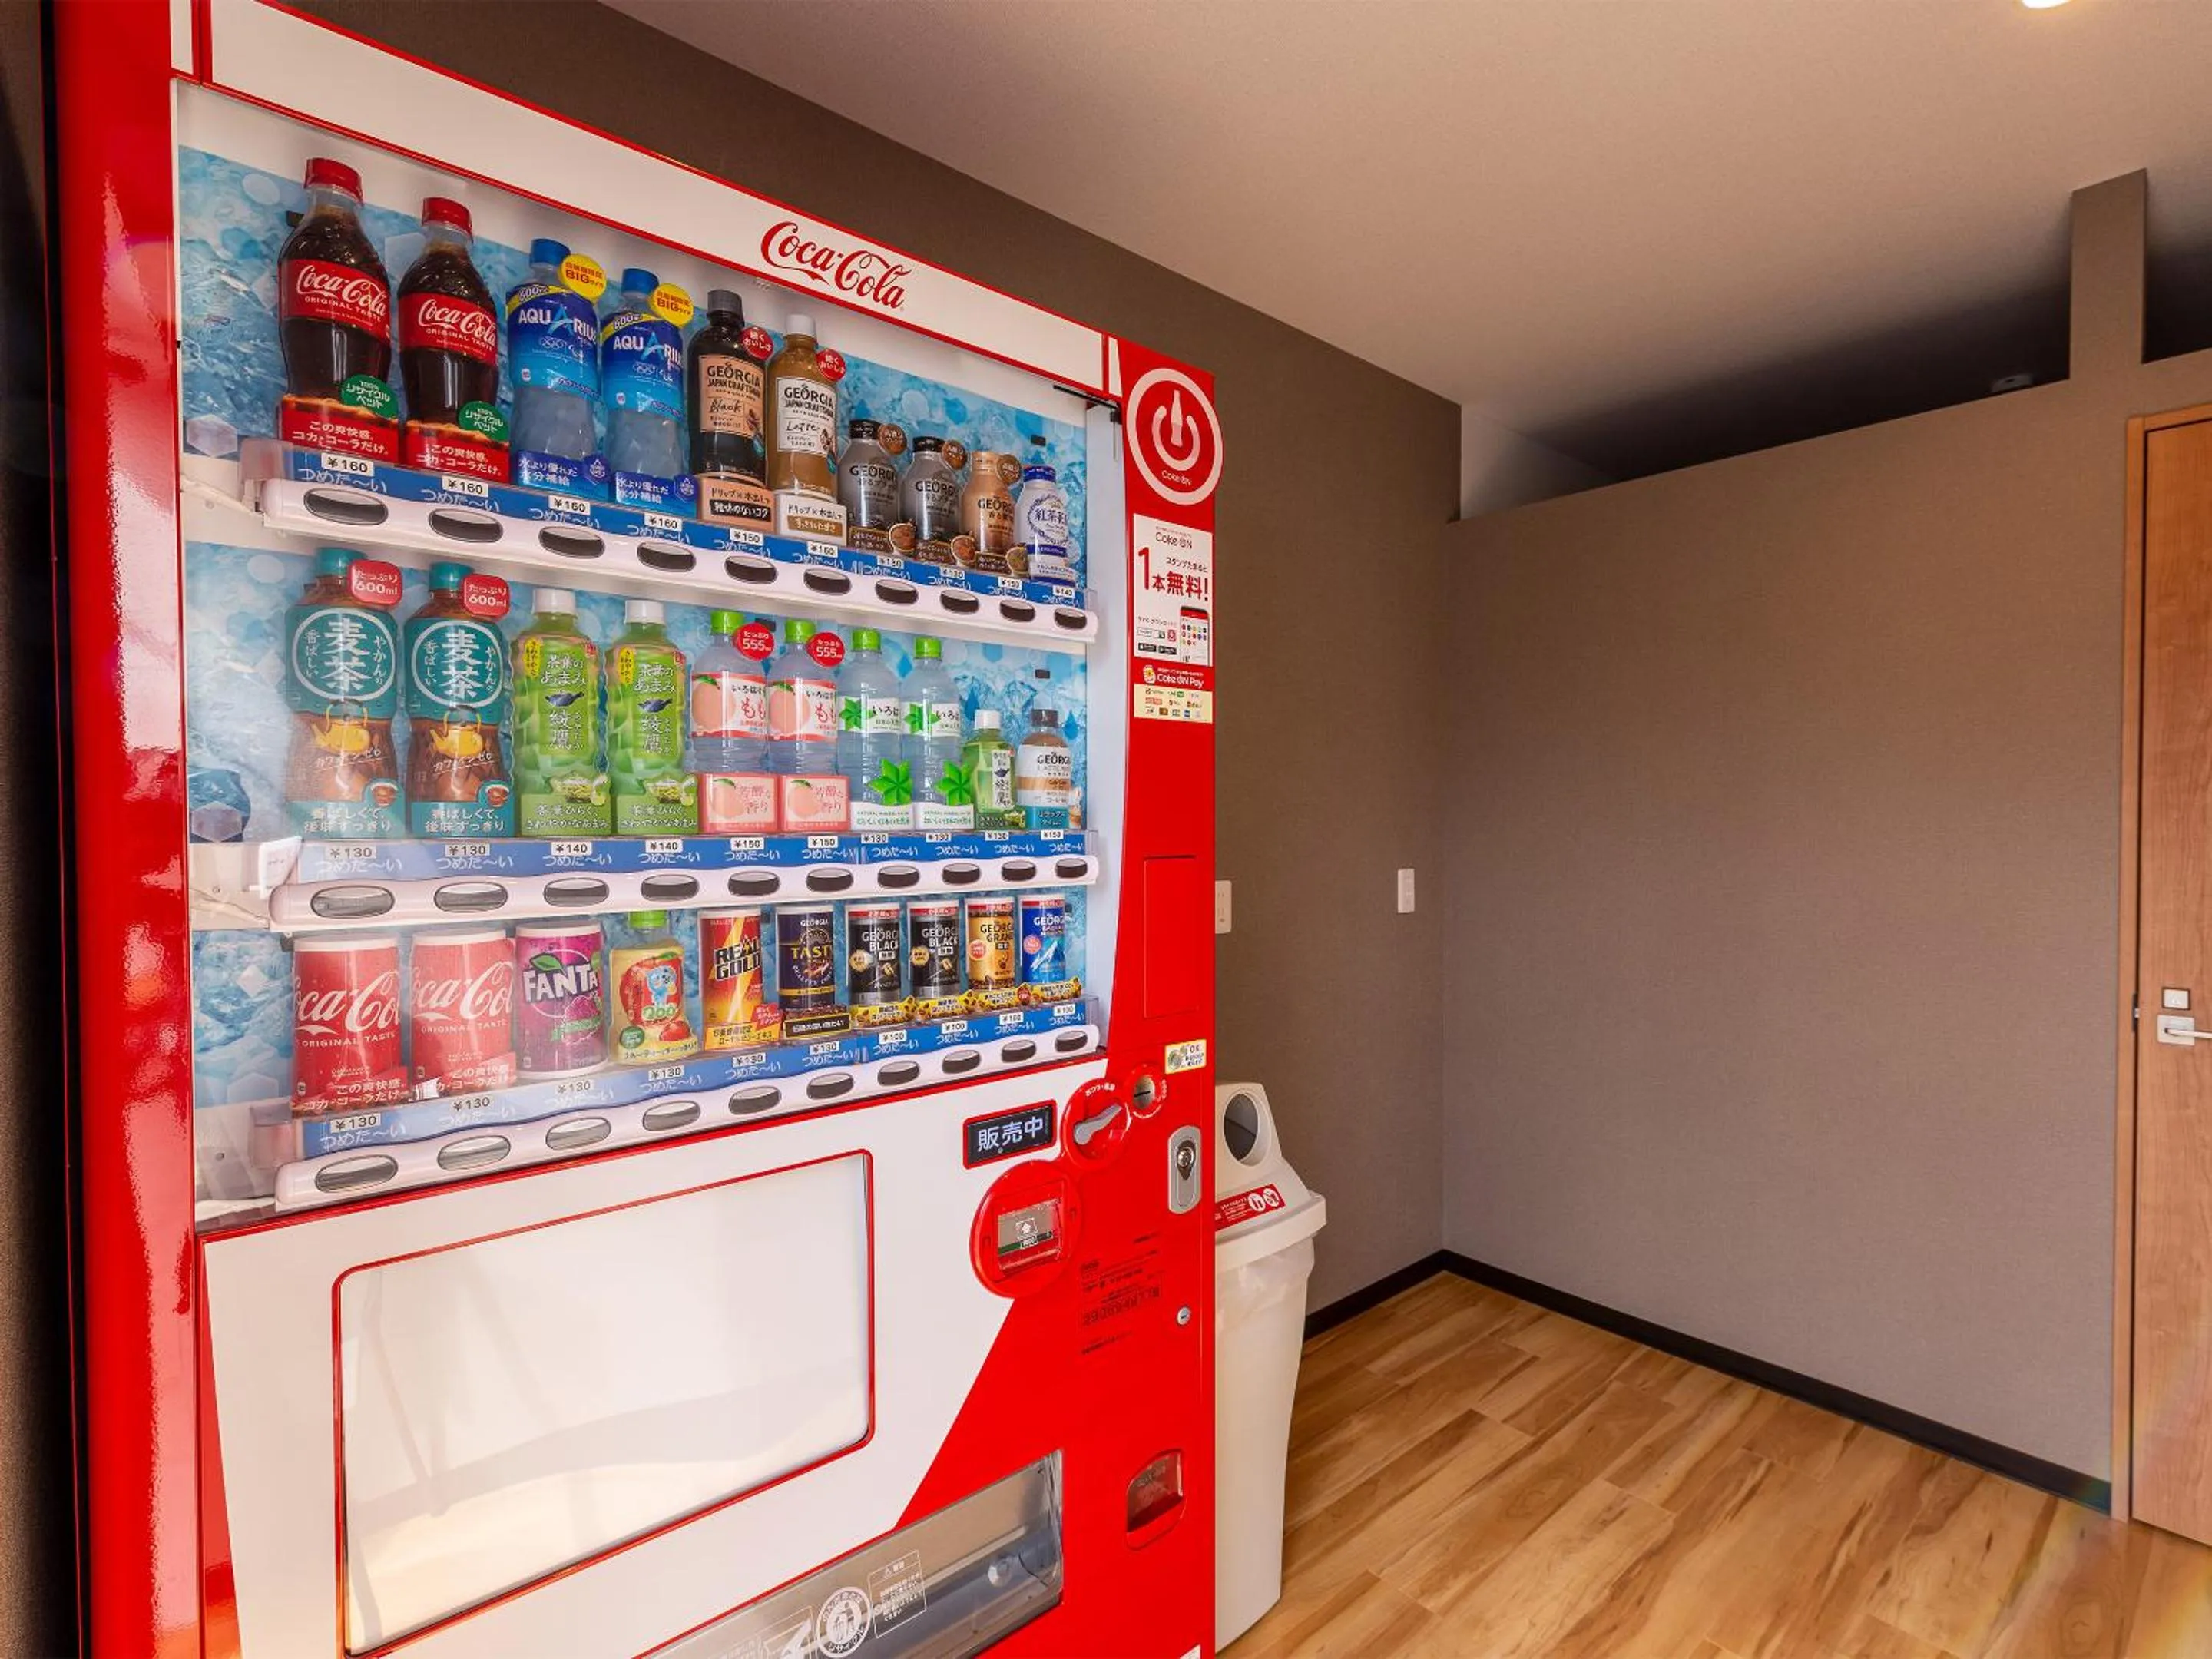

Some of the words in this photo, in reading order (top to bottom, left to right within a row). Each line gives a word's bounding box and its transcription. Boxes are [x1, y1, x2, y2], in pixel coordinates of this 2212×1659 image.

[760, 221, 912, 309] Coca-Cola
[305, 296, 352, 310] ORIGINAL
[426, 328, 469, 341] ORIGINAL
[346, 383, 390, 402] リサイクル
[465, 409, 504, 427] リサイクル
[328, 458, 368, 472] ¥160
[448, 479, 484, 494] ¥160
[554, 499, 586, 512] ¥160
[648, 517, 677, 529] ¥160
[733, 531, 760, 544] ¥150
[356, 570, 397, 583] たっぷり
[356, 580, 398, 596] 600ml
[469, 584, 507, 595] たっぷり
[469, 594, 507, 608] 600ml
[320, 618, 373, 692] 麦茶
[439, 629, 484, 699] 麦茶
[557, 844, 588, 853] ¥140
[651, 841, 678, 850] ¥140
[735, 839, 760, 849] ¥150
[811, 838, 836, 846] ¥150
[330, 847, 373, 858] ¥130
[449, 846, 486, 856] ¥130
[522, 963, 598, 1002] FANTA
[302, 1038, 358, 1047] ORIGINAL
[653, 1067, 681, 1078] ¥130
[558, 1081, 591, 1093] ¥130
[452, 1097, 490, 1111] ¥130
[335, 1115, 377, 1130] ¥130
[977, 1116, 1044, 1153] 販売中
